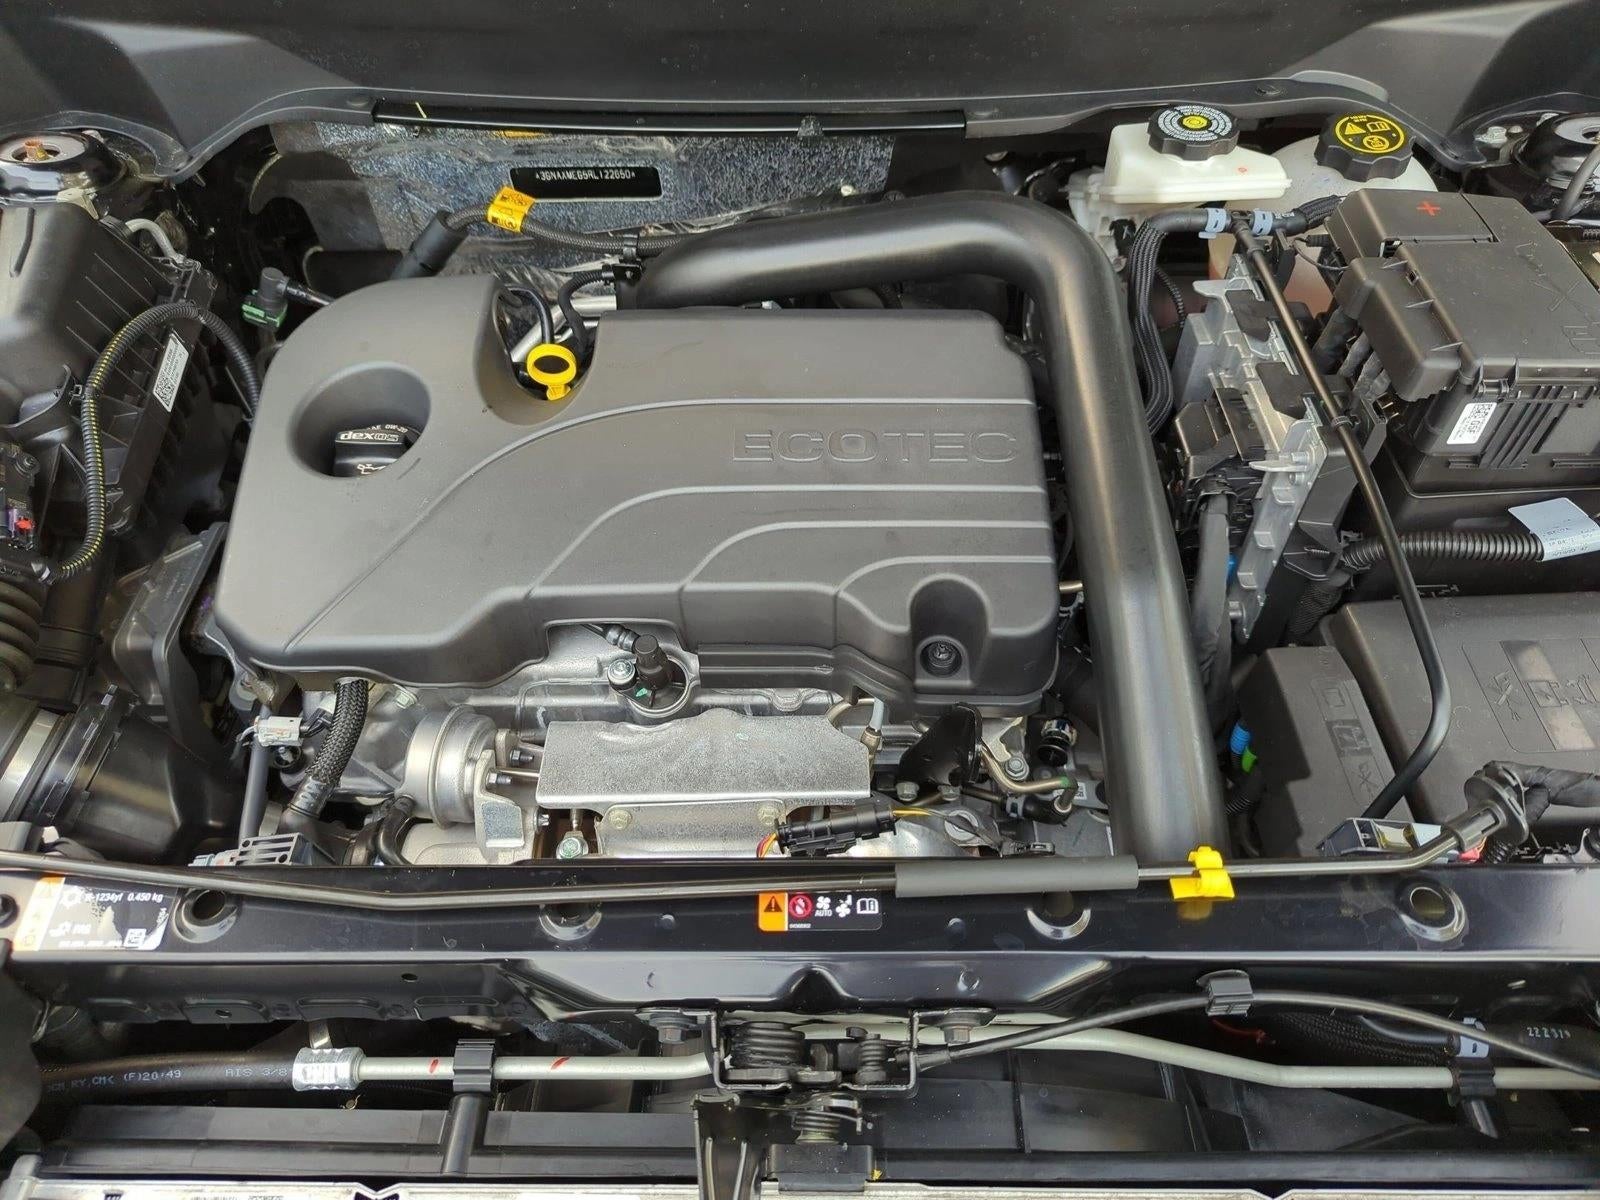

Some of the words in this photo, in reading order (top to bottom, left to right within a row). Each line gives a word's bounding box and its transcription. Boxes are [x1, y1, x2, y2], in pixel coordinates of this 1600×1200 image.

[733, 431, 1017, 463] ECOTEC
[127, 892, 152, 902] 0.450
[152, 892, 164, 903] kg
[814, 909, 833, 917] AUTO
